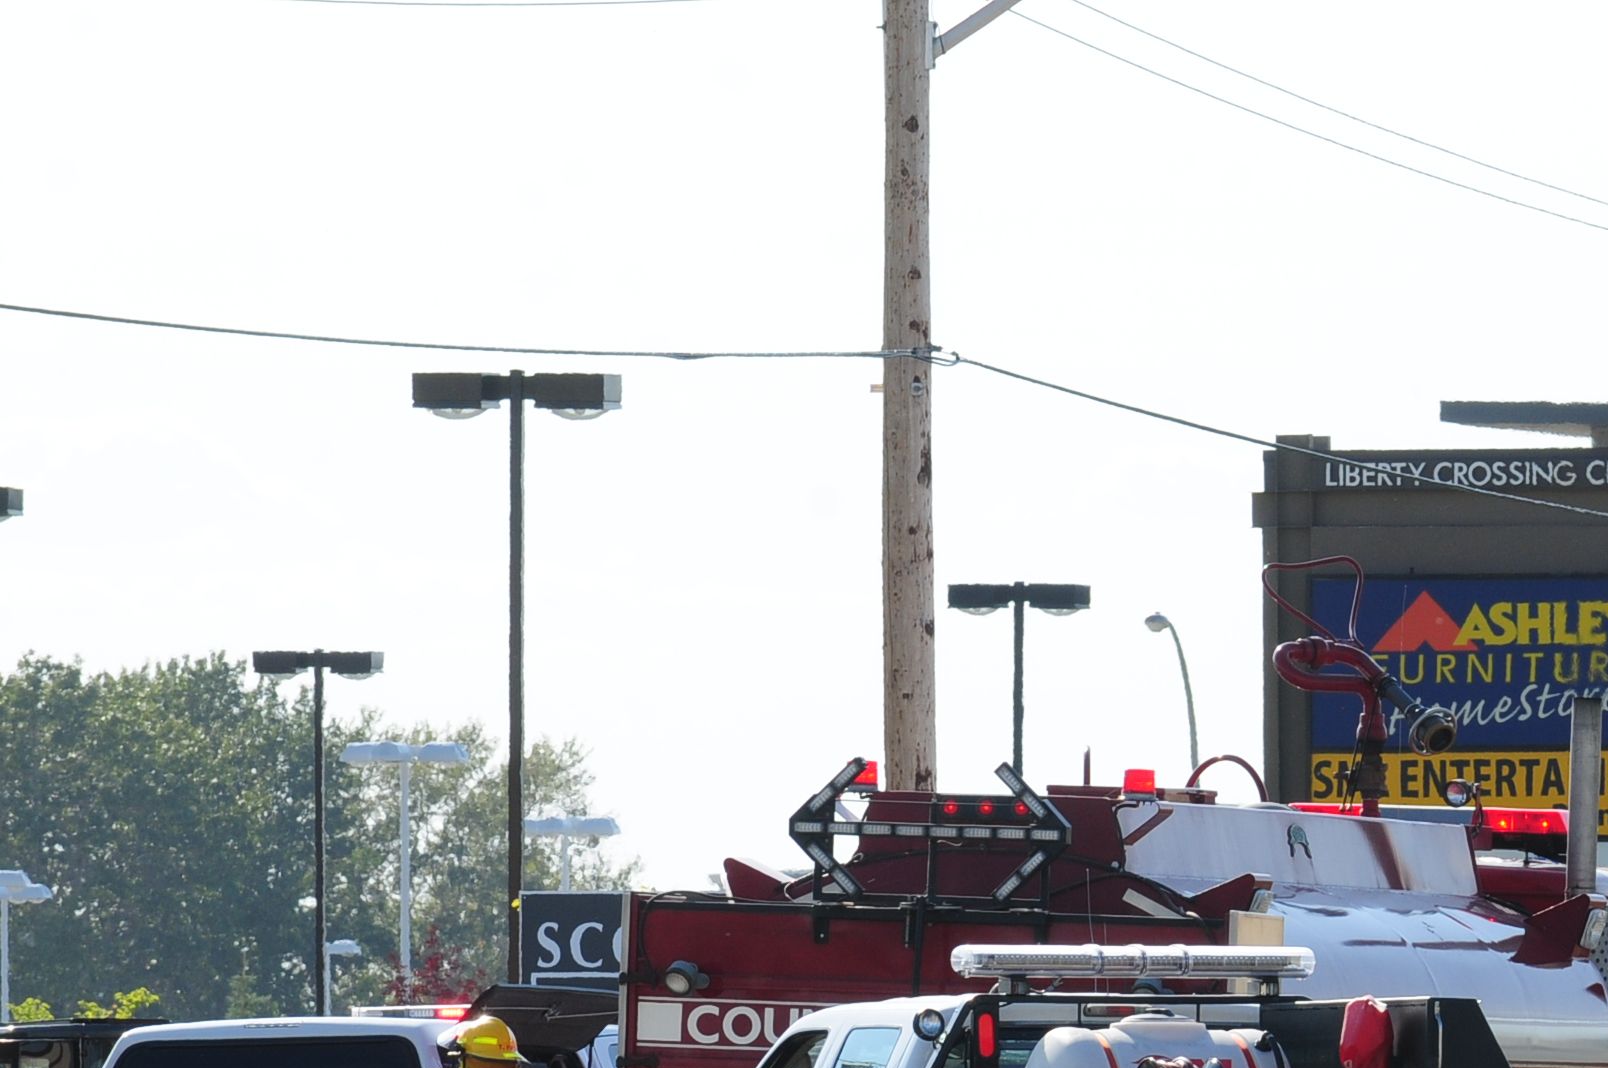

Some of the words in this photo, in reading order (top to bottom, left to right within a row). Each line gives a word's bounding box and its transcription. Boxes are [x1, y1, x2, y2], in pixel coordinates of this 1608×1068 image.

[1325, 462, 1427, 487] LIBERTY
[1433, 461, 1577, 486] CROSSING
[537, 921, 622, 968] SC
[687, 1004, 822, 1045] COU
